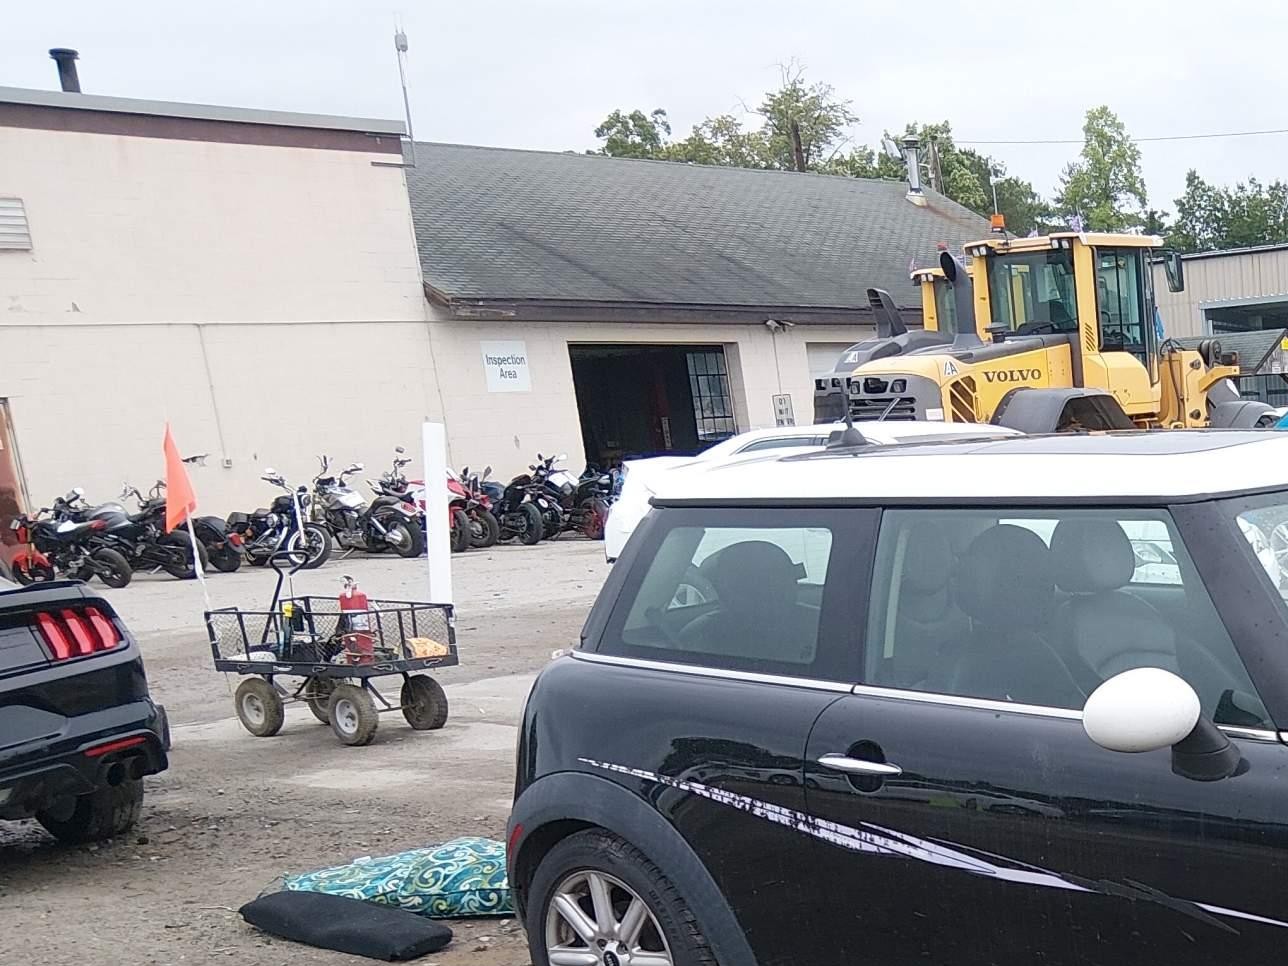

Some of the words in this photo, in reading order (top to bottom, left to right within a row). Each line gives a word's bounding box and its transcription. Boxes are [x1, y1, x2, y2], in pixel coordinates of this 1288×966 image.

[485, 353, 526, 367] Inspection
[499, 367, 518, 379] Area
[982, 368, 1042, 383] VOLVO
